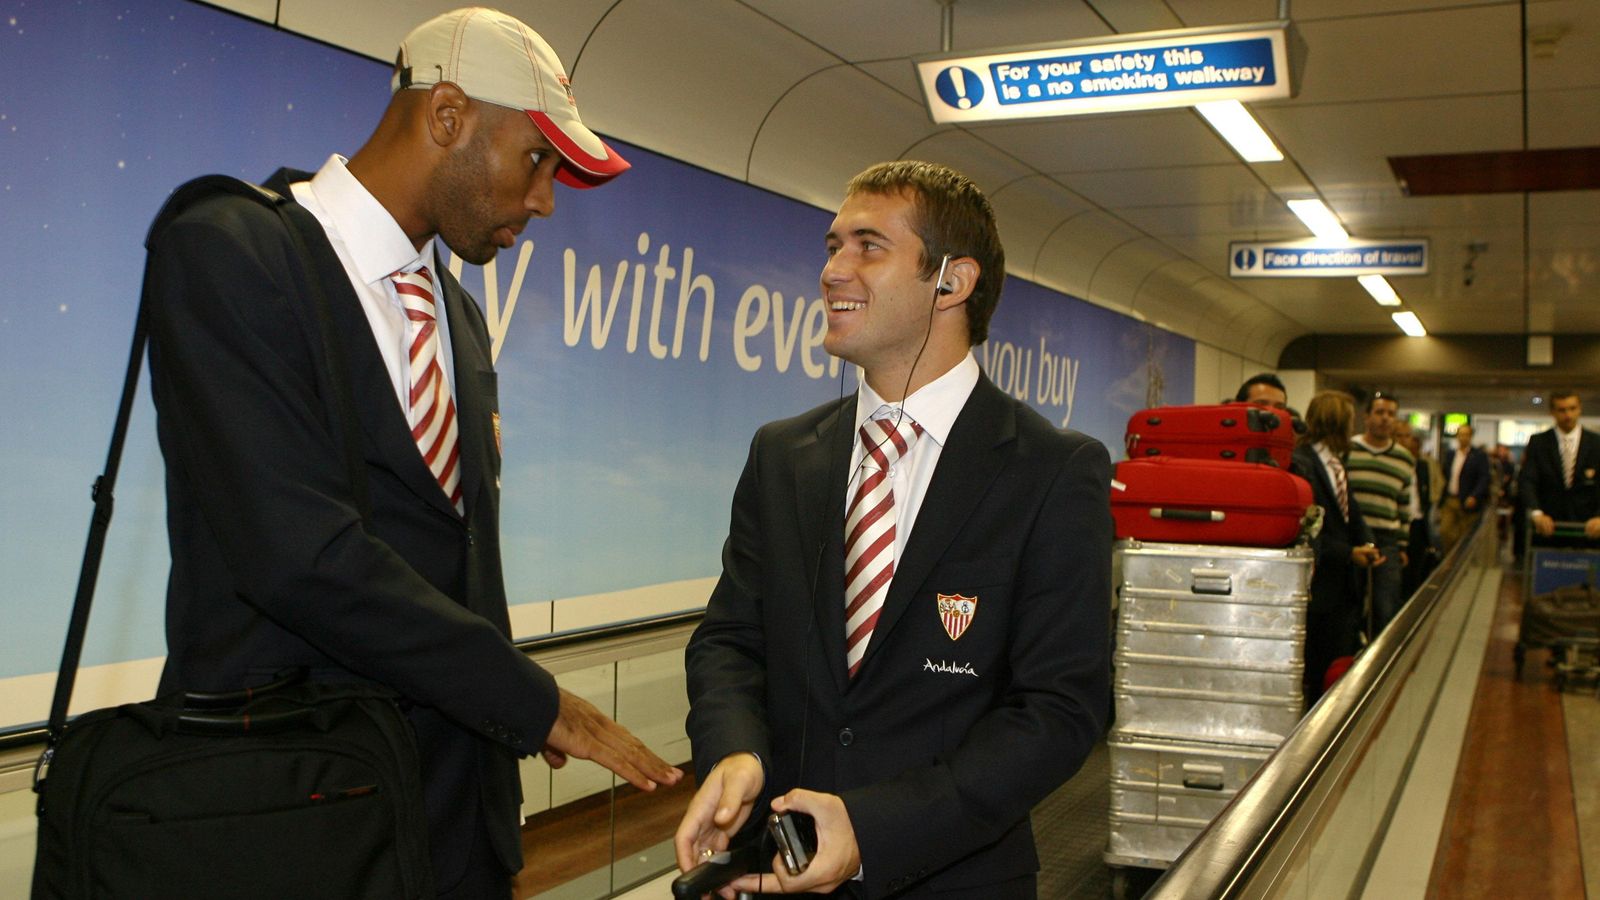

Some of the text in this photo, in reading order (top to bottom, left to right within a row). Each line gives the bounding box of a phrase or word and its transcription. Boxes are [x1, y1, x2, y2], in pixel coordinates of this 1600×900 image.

[997, 48, 1203, 82] For your safety this
[1002, 64, 1265, 101] is a no smoking walkway
[1266, 249, 1423, 266] Face direction of travel
[563, 232, 715, 362] with
[982, 338, 1033, 401] you
[1037, 335, 1080, 428] buy
[923, 657, 979, 677] Andalucía
